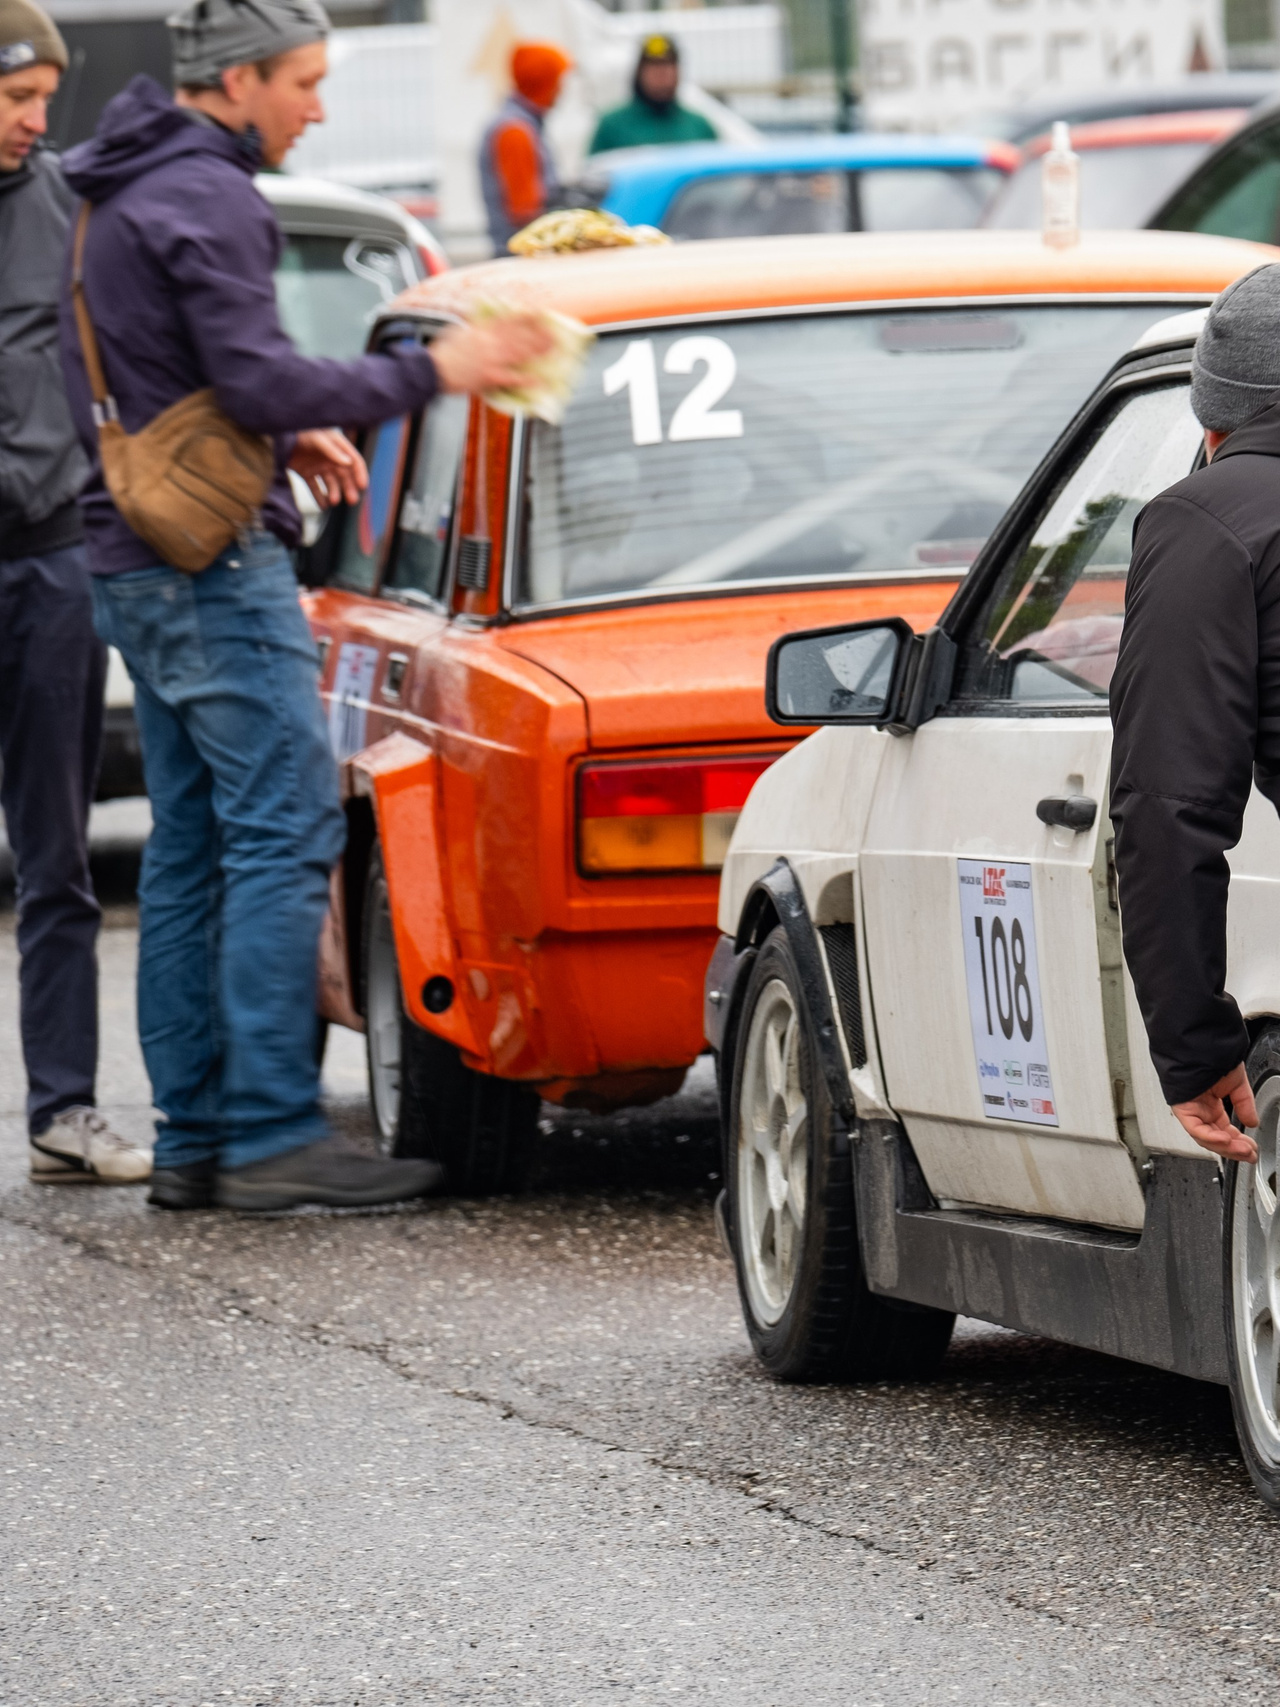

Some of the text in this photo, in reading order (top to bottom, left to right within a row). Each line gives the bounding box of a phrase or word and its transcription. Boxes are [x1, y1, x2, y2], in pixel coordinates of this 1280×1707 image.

[862, 31, 1154, 92] БАГГИ
[602, 335, 744, 445] 12
[974, 915, 1033, 1043] 108
